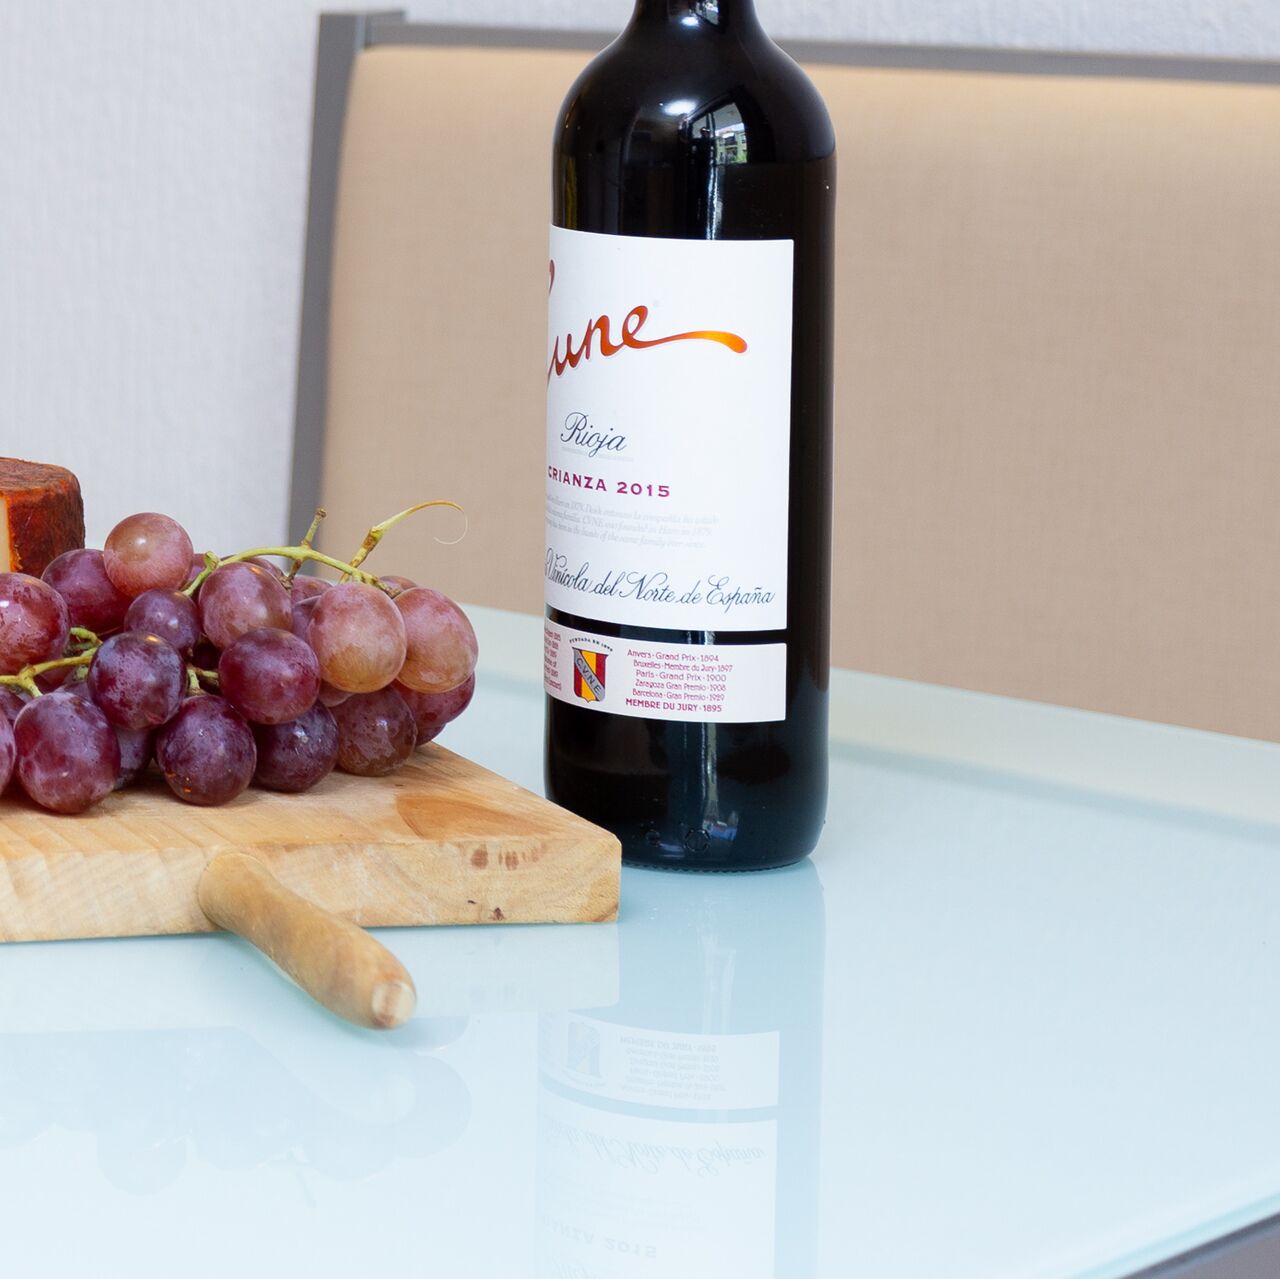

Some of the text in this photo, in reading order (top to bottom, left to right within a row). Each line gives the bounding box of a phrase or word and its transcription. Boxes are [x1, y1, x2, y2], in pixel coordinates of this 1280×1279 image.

[546, 260, 747, 392] une
[560, 412, 627, 457] Rioja
[548, 465, 670, 497] CRIANZA 2015
[589, 570, 626, 597] del
[620, 571, 676, 602] Norte
[675, 580, 703, 604] de
[706, 574, 776, 614] España
[627, 649, 651, 659] Anvers
[655, 652, 680, 660] Grand
[681, 653, 696, 662] Prix
[636, 669, 654, 678] Paris
[659, 671, 684, 680] Grand
[686, 673, 701, 681] Prix
[625, 698, 660, 709] MEMBRE
[662, 702, 675, 710] DU
[677, 703, 698, 712] JURY
